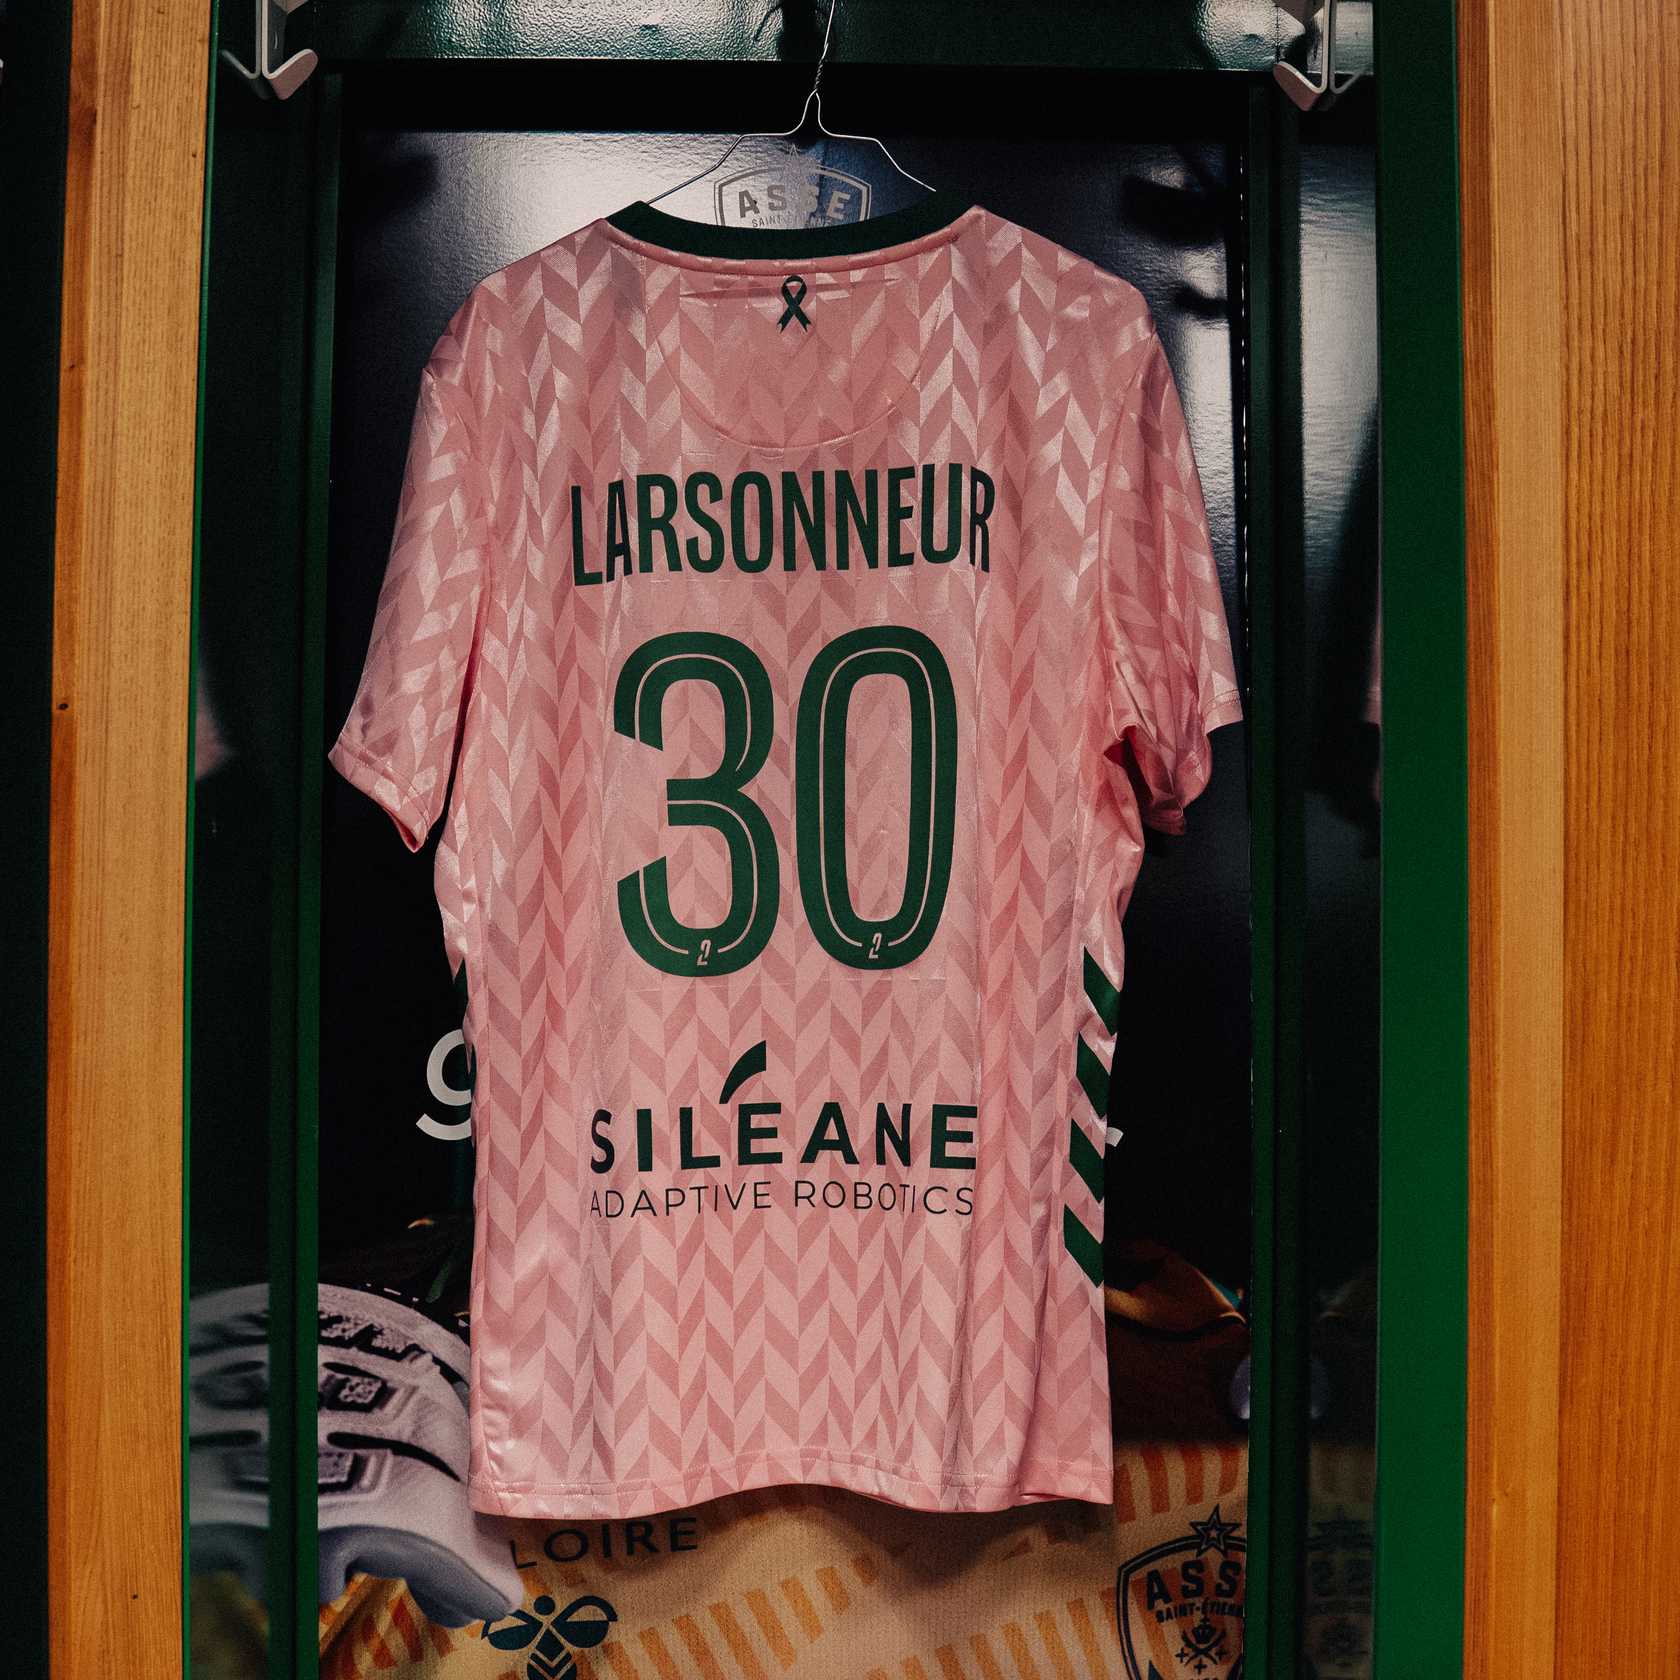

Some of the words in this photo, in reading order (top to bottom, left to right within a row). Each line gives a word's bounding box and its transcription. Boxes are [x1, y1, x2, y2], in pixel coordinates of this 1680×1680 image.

[570, 463, 996, 586] LARSONNEUR
[613, 625, 958, 977] 30
[590, 1040, 978, 1174] SILÉANE
[590, 1181, 772, 1218] ADAPTIVE
[794, 1180, 974, 1216] ROBOTICS
[510, 1517, 698, 1569] LOIRE
